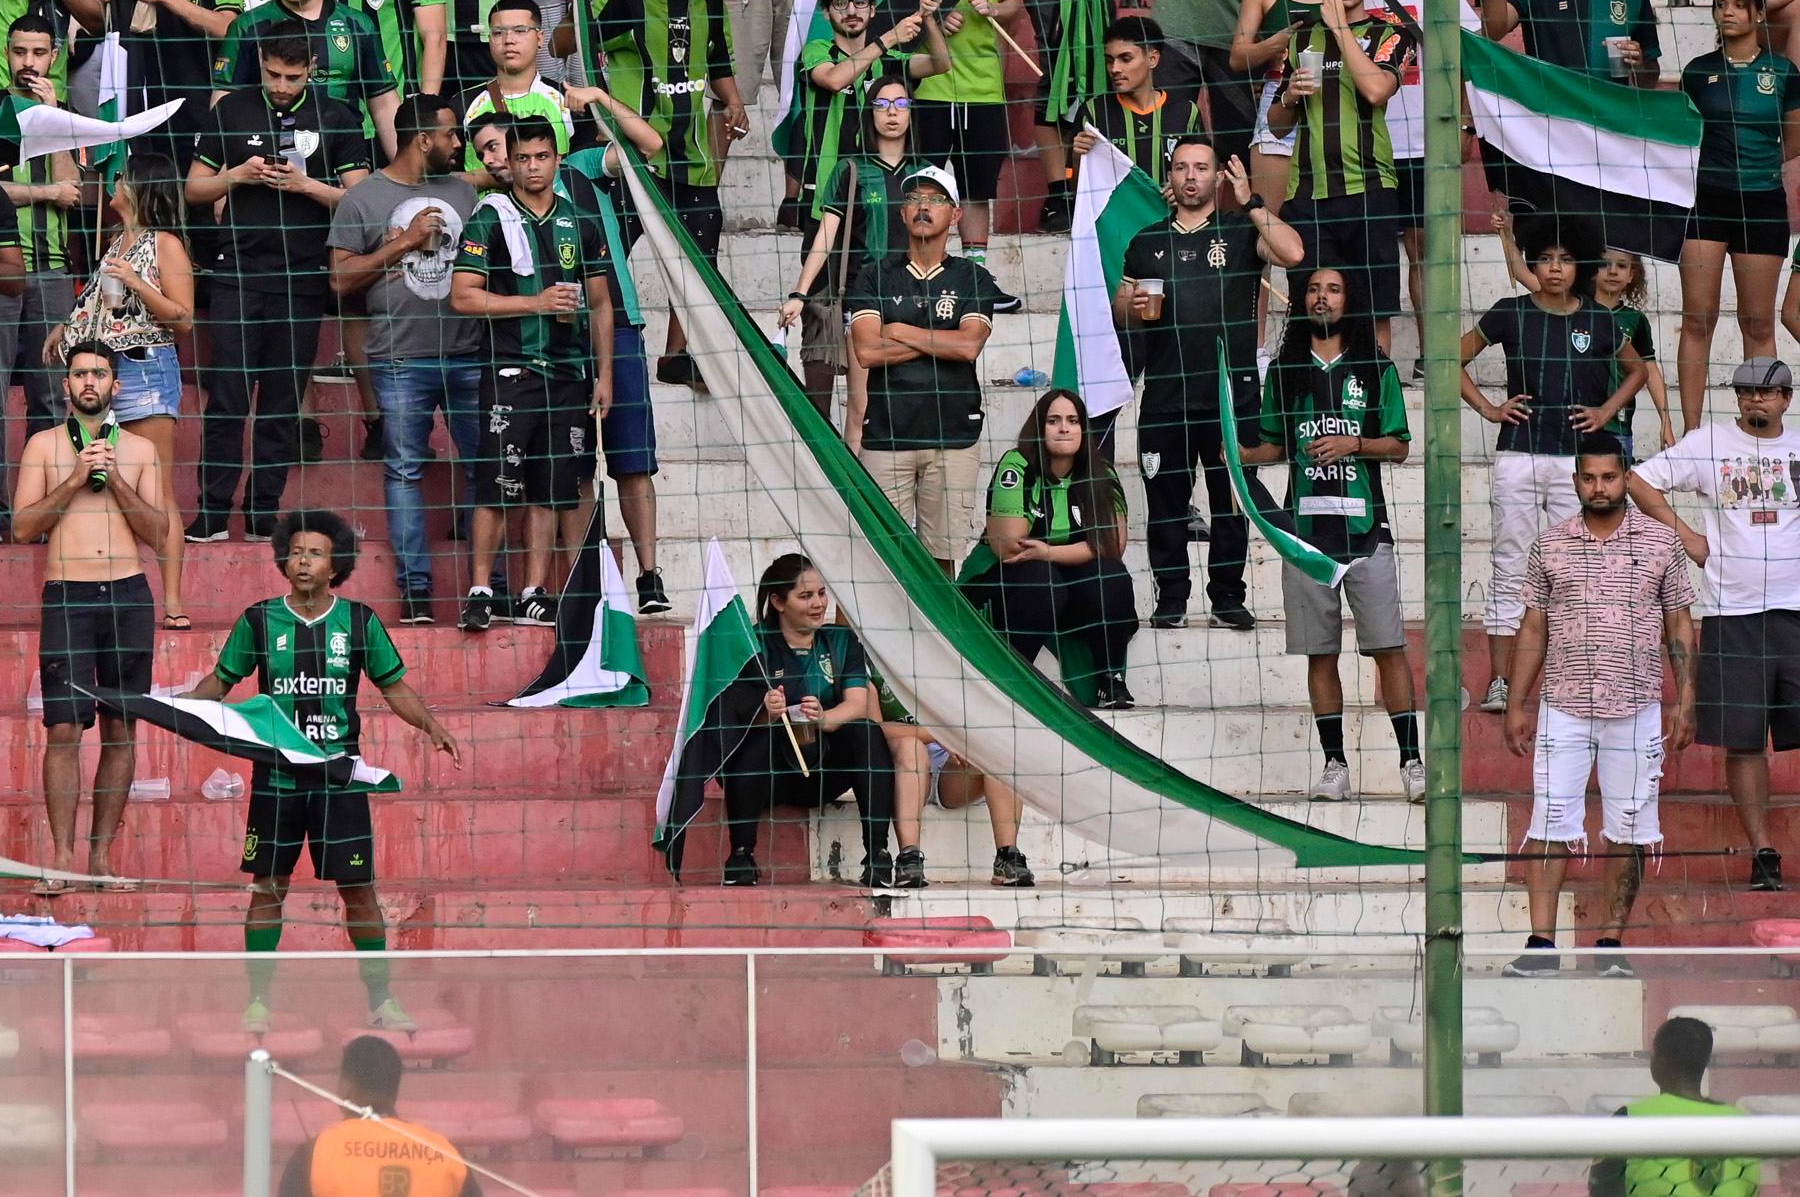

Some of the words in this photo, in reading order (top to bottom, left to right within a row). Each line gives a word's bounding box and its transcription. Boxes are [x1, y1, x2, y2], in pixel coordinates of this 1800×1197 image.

[1299, 413, 1361, 439] sixtema
[1304, 464, 1358, 482] PARIS
[273, 671, 347, 695] sixtema
[306, 714, 337, 723] ARENA
[342, 1140, 445, 1165] SEGURANÇA
